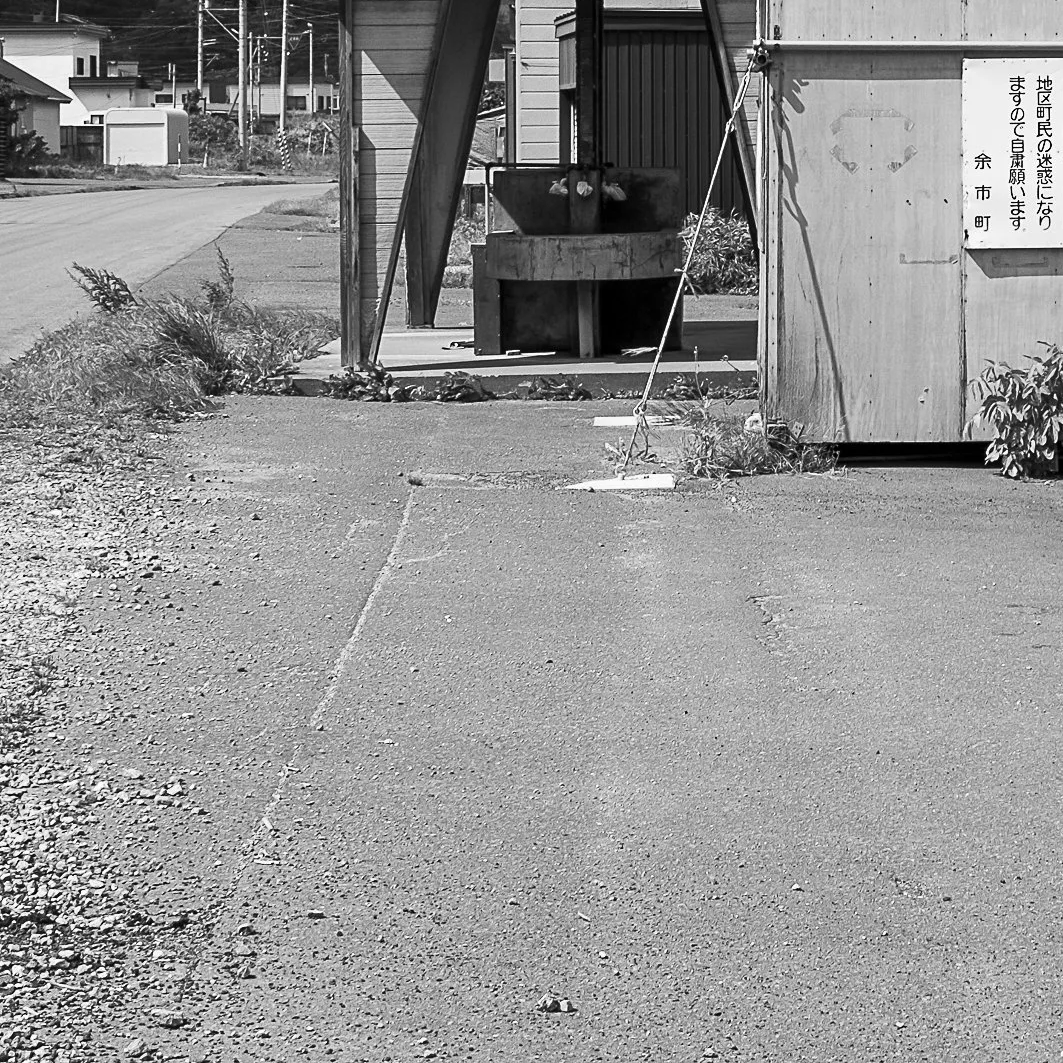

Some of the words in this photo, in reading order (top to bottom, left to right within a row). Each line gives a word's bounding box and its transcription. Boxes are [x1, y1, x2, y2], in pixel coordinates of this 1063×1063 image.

[974, 153, 992, 231] 余市町
[1008, 75, 1026, 230] ますので自粛願います
[1036, 75, 1053, 230] 地区町民の迷惑になり
